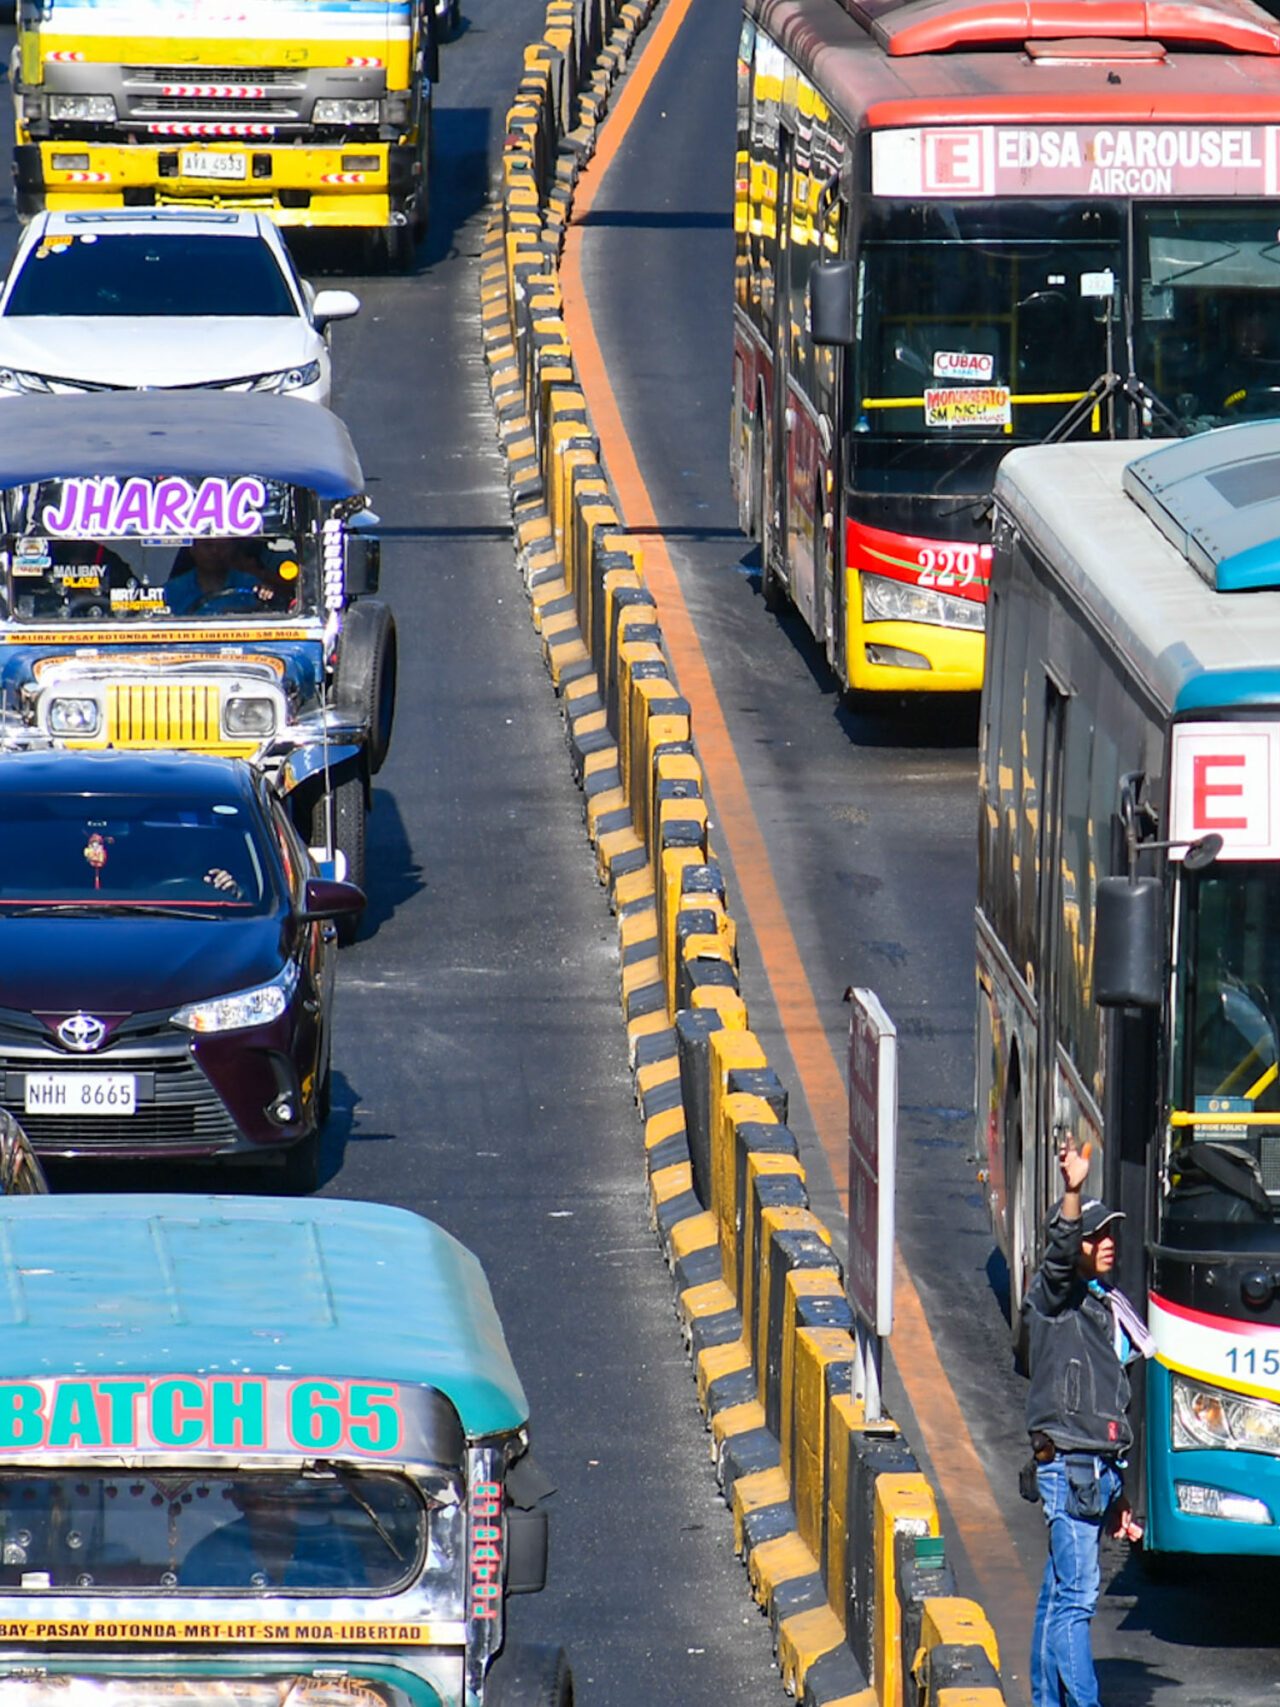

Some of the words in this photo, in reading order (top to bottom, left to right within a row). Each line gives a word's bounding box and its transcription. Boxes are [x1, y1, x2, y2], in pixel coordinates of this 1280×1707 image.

[998, 131, 1082, 168] EDSA
[1092, 130, 1262, 168] CAROUSEL
[1088, 168, 1172, 194] AIRCON
[936, 353, 991, 371] CUBAO
[43, 477, 265, 536] JHARAC
[53, 565, 107, 578] MALIBAY
[62, 577, 100, 588] PLAZA
[917, 549, 976, 587] 229
[1193, 755, 1248, 830] E
[29, 1084, 66, 1105] NHH
[81, 1084, 131, 1105] 8665
[0, 1374, 269, 1453] BATCH
[286, 1376, 403, 1455] 65
